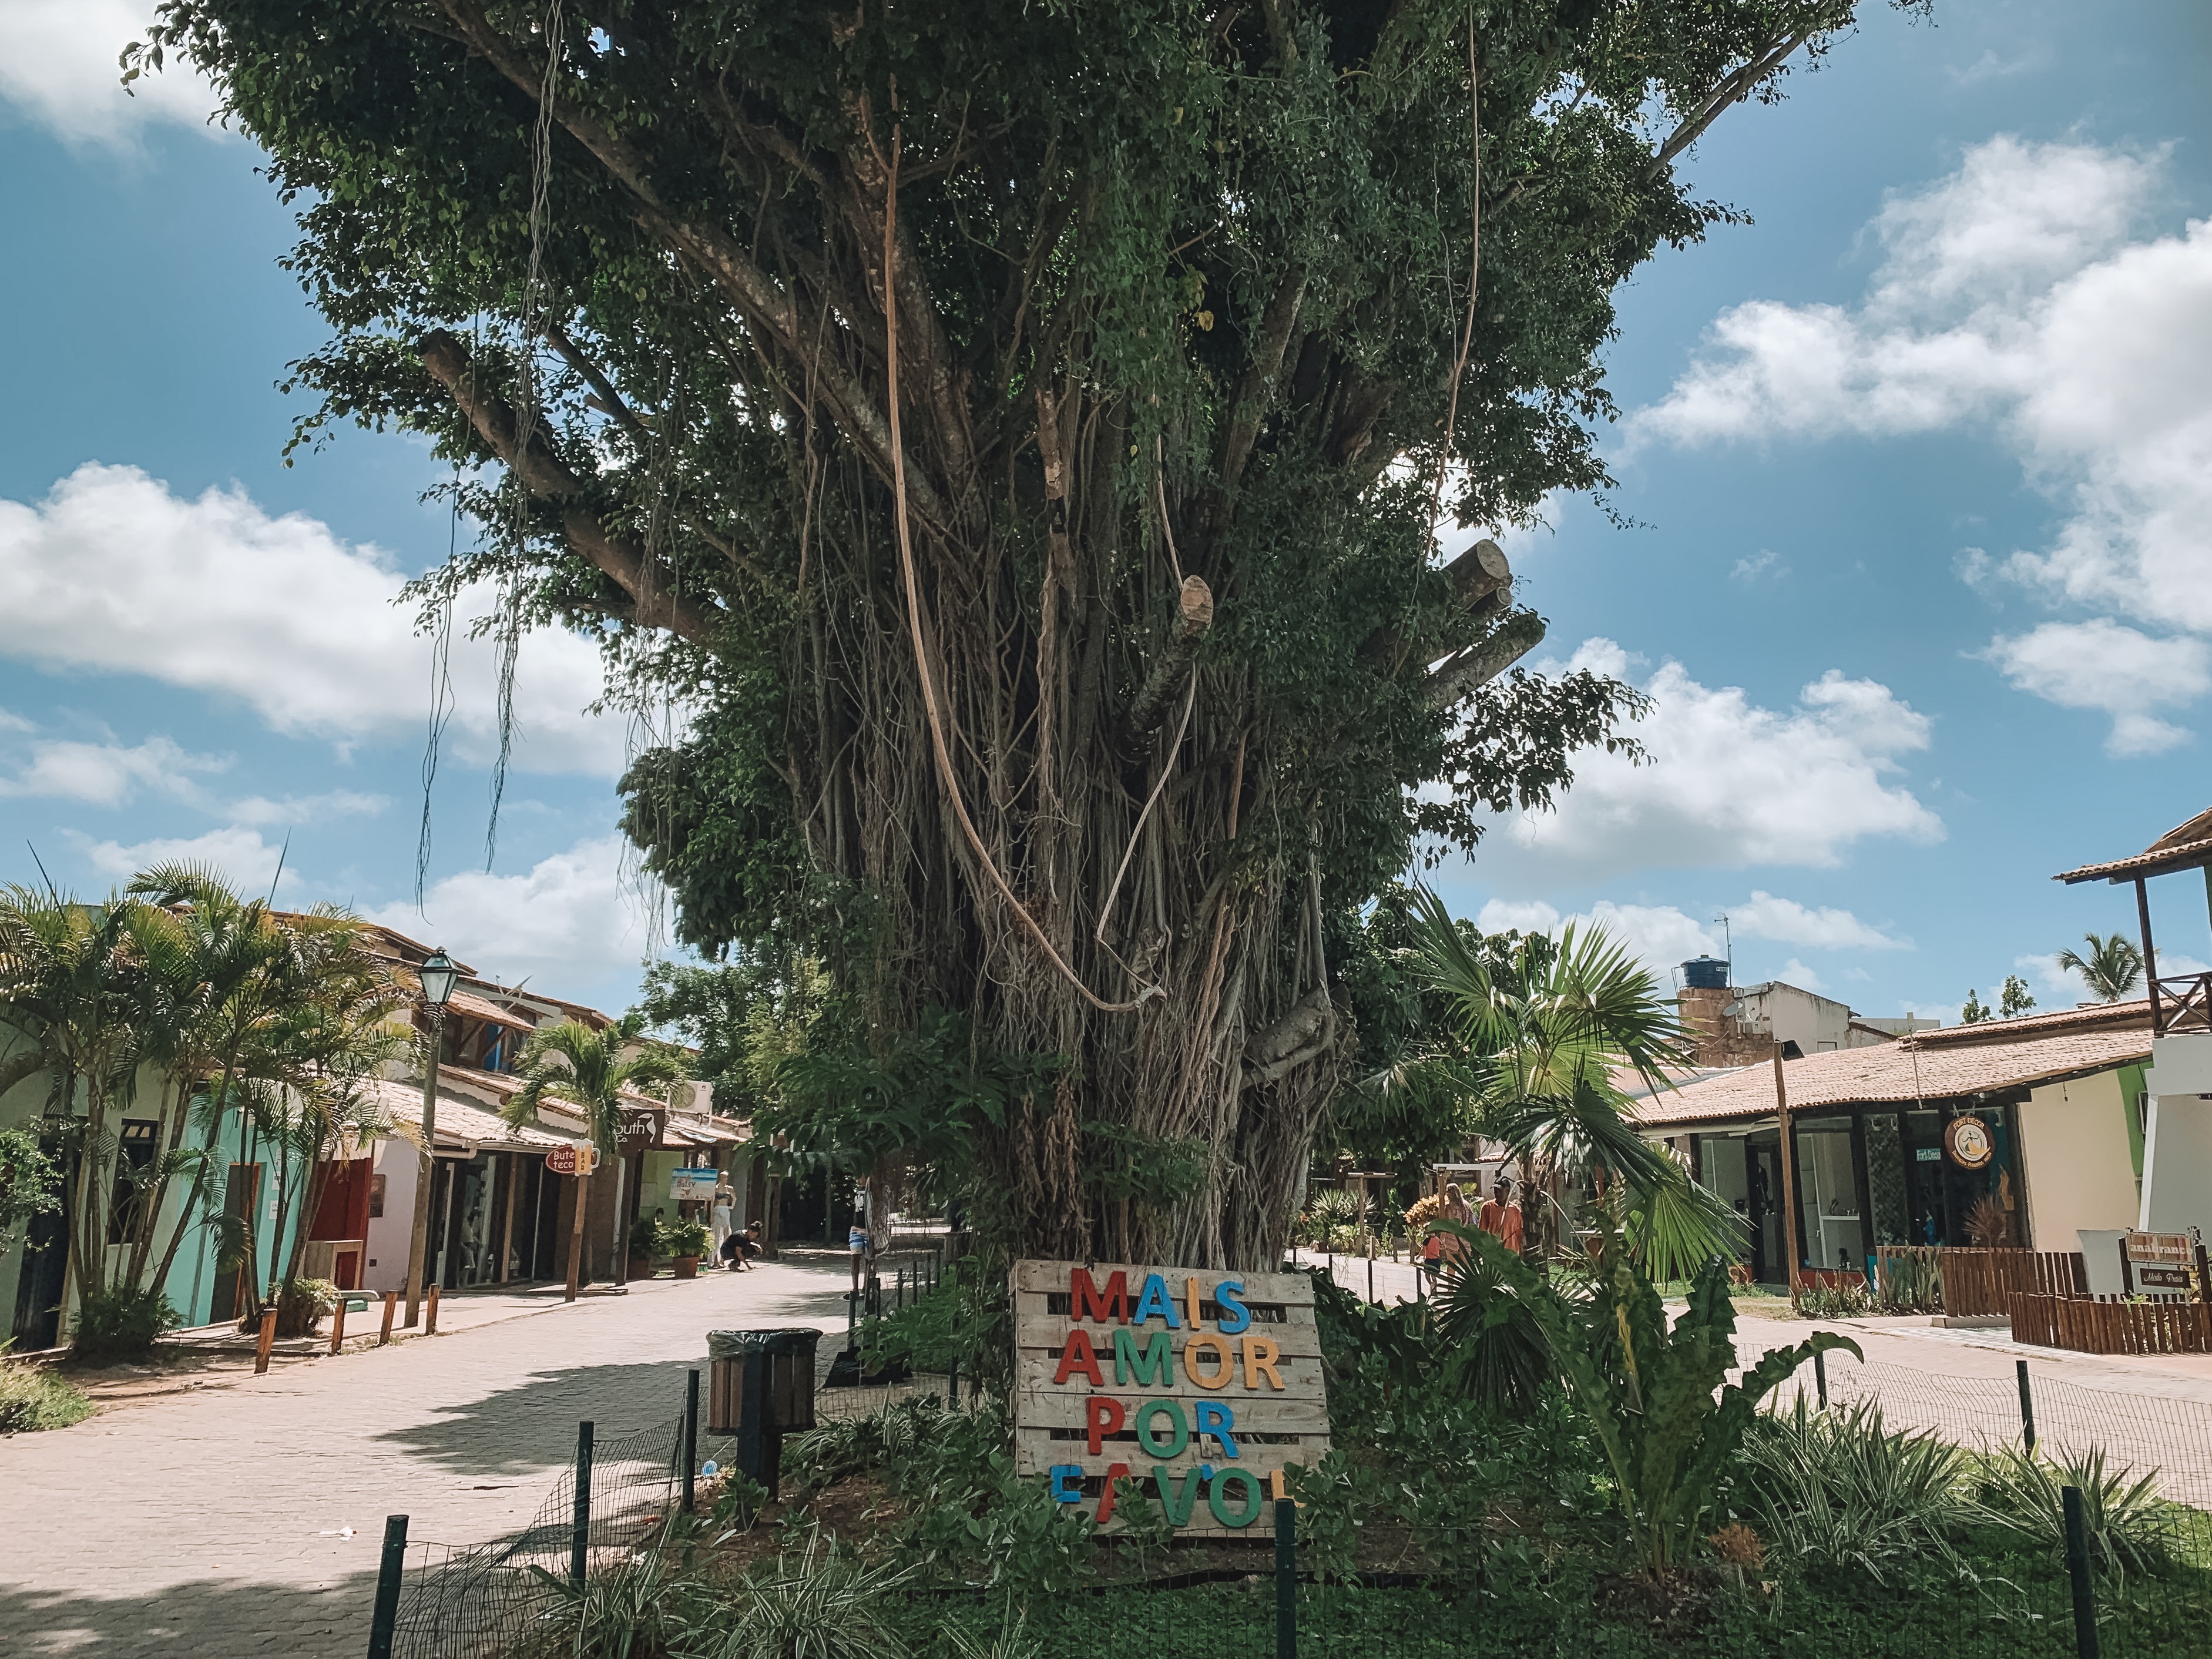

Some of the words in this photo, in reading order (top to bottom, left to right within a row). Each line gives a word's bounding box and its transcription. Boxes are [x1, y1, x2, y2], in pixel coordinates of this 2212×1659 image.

[615, 1120, 645, 1135] outh
[1953, 1118, 1966, 1131] FORT
[1967, 1117, 1985, 1130] DECOR
[553, 1150, 575, 1161] Bute
[553, 1160, 573, 1169] teco
[1070, 1267, 1251, 1335] MAIS
[1053, 1329, 1285, 1391] AMOR
[1085, 1396, 1239, 1459] POR
